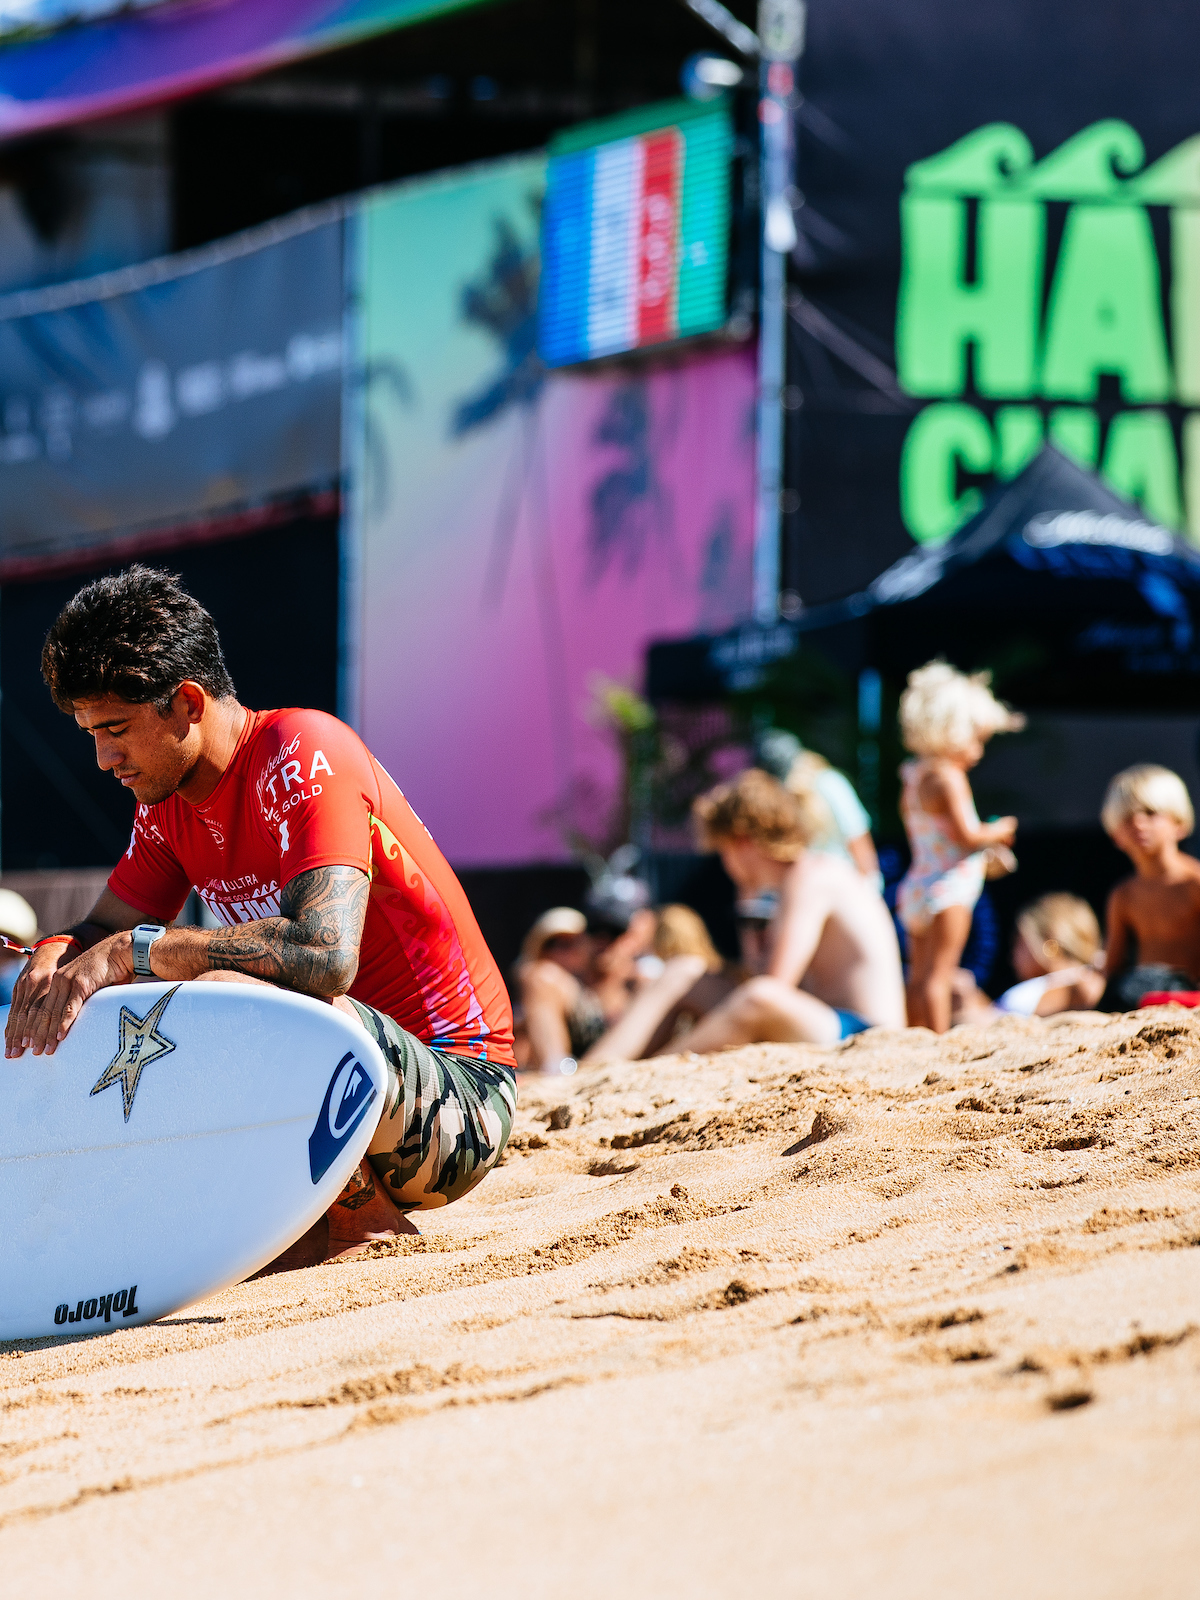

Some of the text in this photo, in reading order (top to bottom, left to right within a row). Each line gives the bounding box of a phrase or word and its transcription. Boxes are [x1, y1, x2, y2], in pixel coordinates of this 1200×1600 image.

[282, 784, 323, 813] GOLD
[226, 873, 259, 891] ULTRA
[233, 893, 251, 902] GOLD
[54, 1285, 138, 1325] Tokoro
